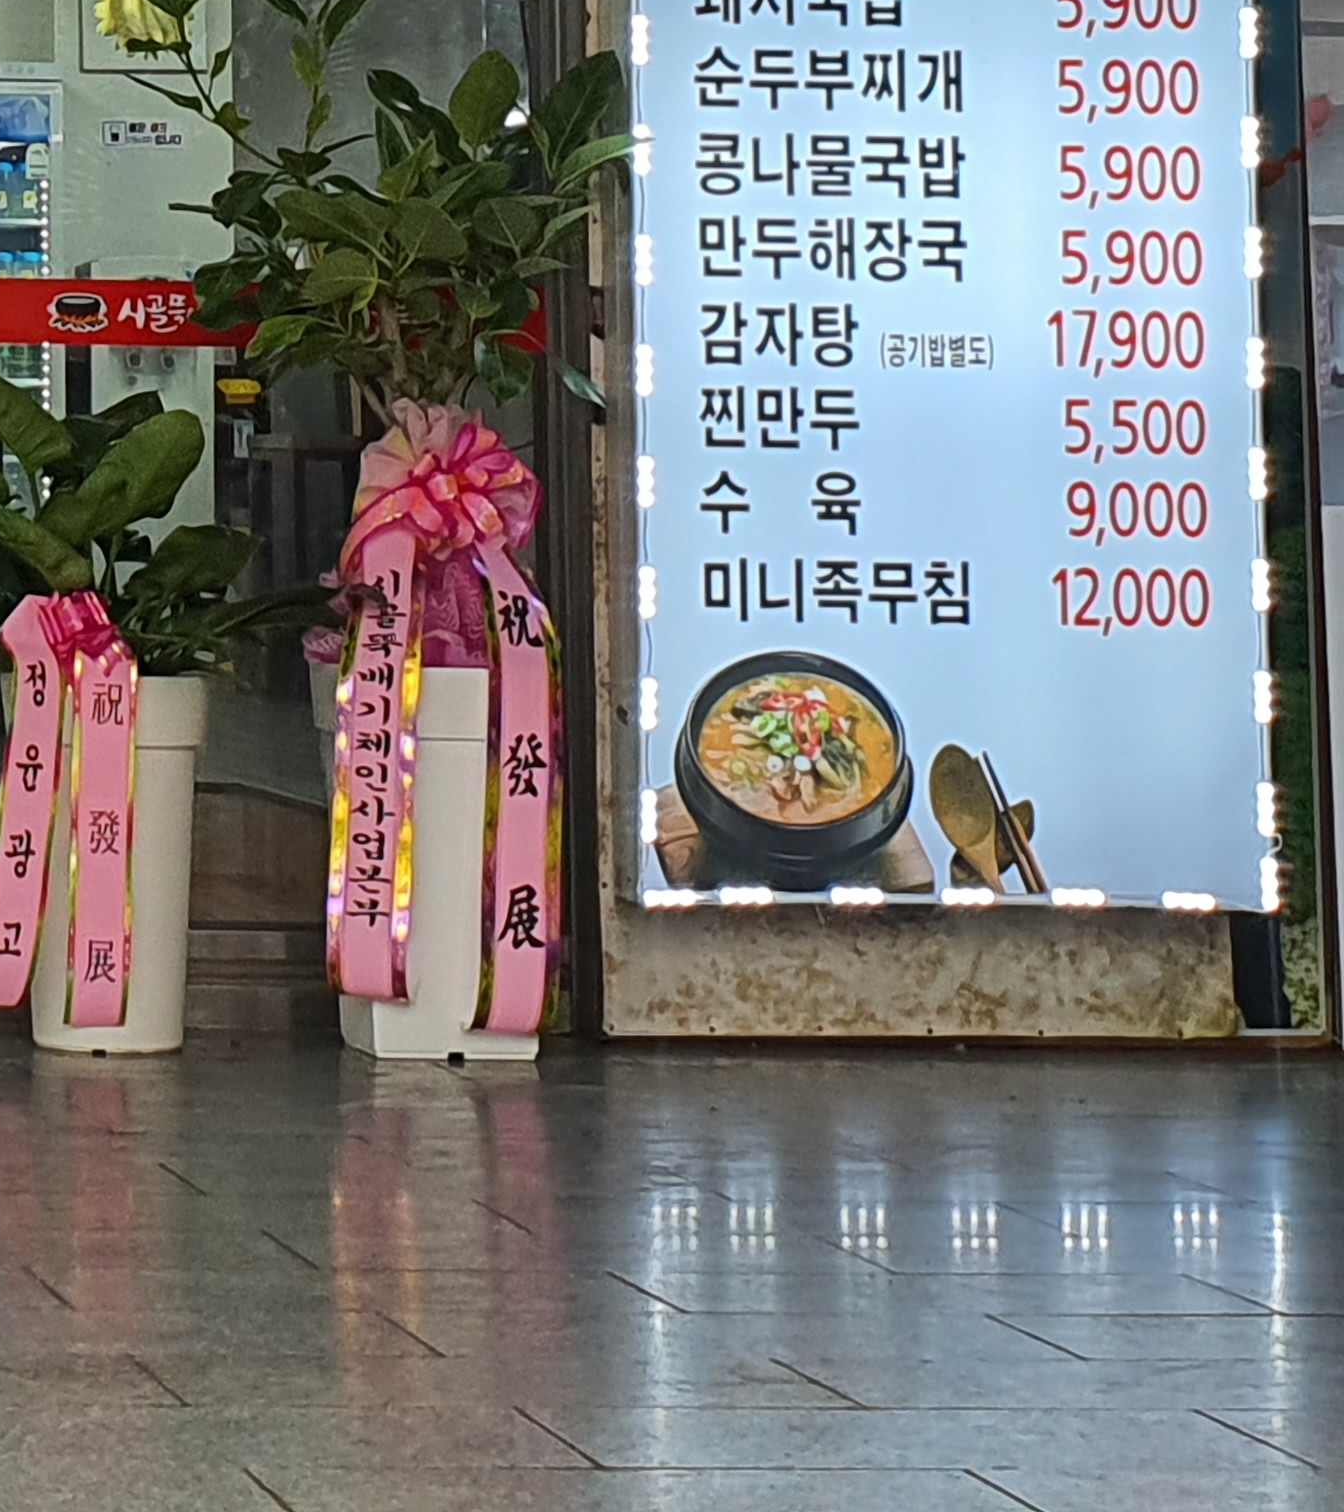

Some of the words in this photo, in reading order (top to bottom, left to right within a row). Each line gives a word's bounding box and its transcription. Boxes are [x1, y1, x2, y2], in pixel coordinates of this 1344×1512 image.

[693, 45, 963, 113] 순두부찌개
[1060, 60, 1197, 116] 5,900
[695, 132, 966, 200] 콩나물국밥
[1062, 145, 1200, 202] 5,900
[698, 215, 968, 283] 만두해장국
[1063, 230, 1203, 286] 5,900
[700, 301, 860, 368] 감자탕
[879, 332, 995, 371] (공기밥별도)
[1050, 310, 1204, 370] 17,900
[699, 385, 861, 452] 찐만두
[1067, 399, 1204, 456] 5,500
[1069, 481, 1207, 539] 9,000
[703, 557, 971, 626] 미니족무침
[1055, 567, 1210, 628] 12,000
